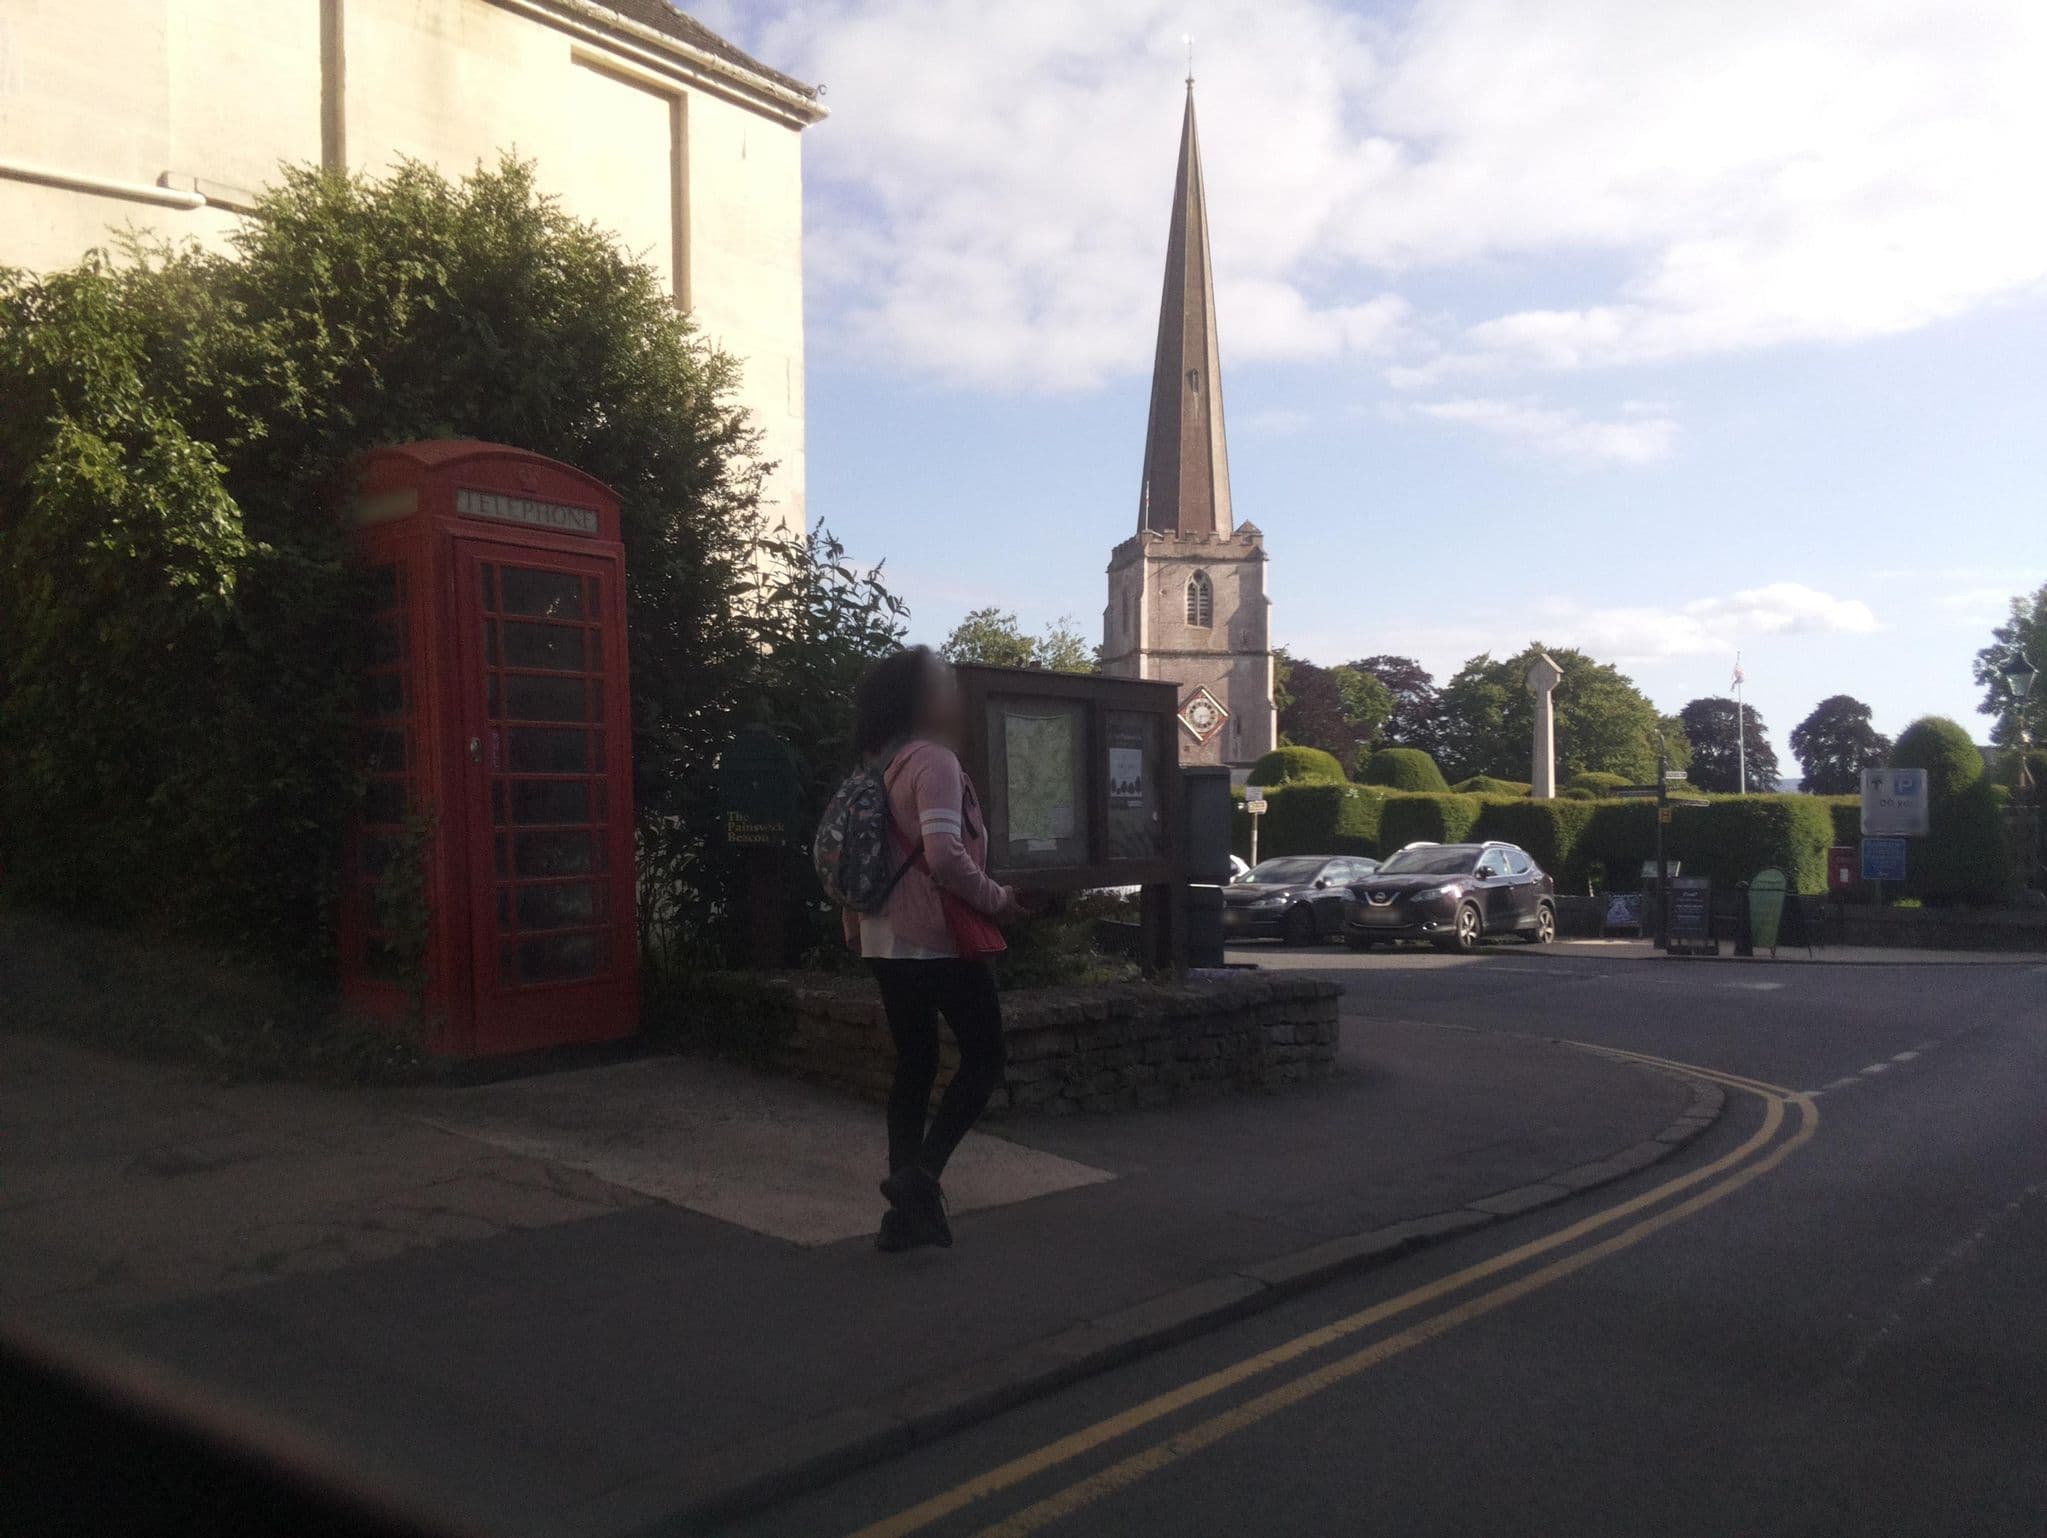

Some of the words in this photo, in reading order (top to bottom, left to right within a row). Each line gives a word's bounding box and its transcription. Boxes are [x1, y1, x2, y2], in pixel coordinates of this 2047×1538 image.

[464, 491, 594, 529] TELEPHONE
[726, 810, 751, 821] The
[726, 832, 770, 842] Beacon
